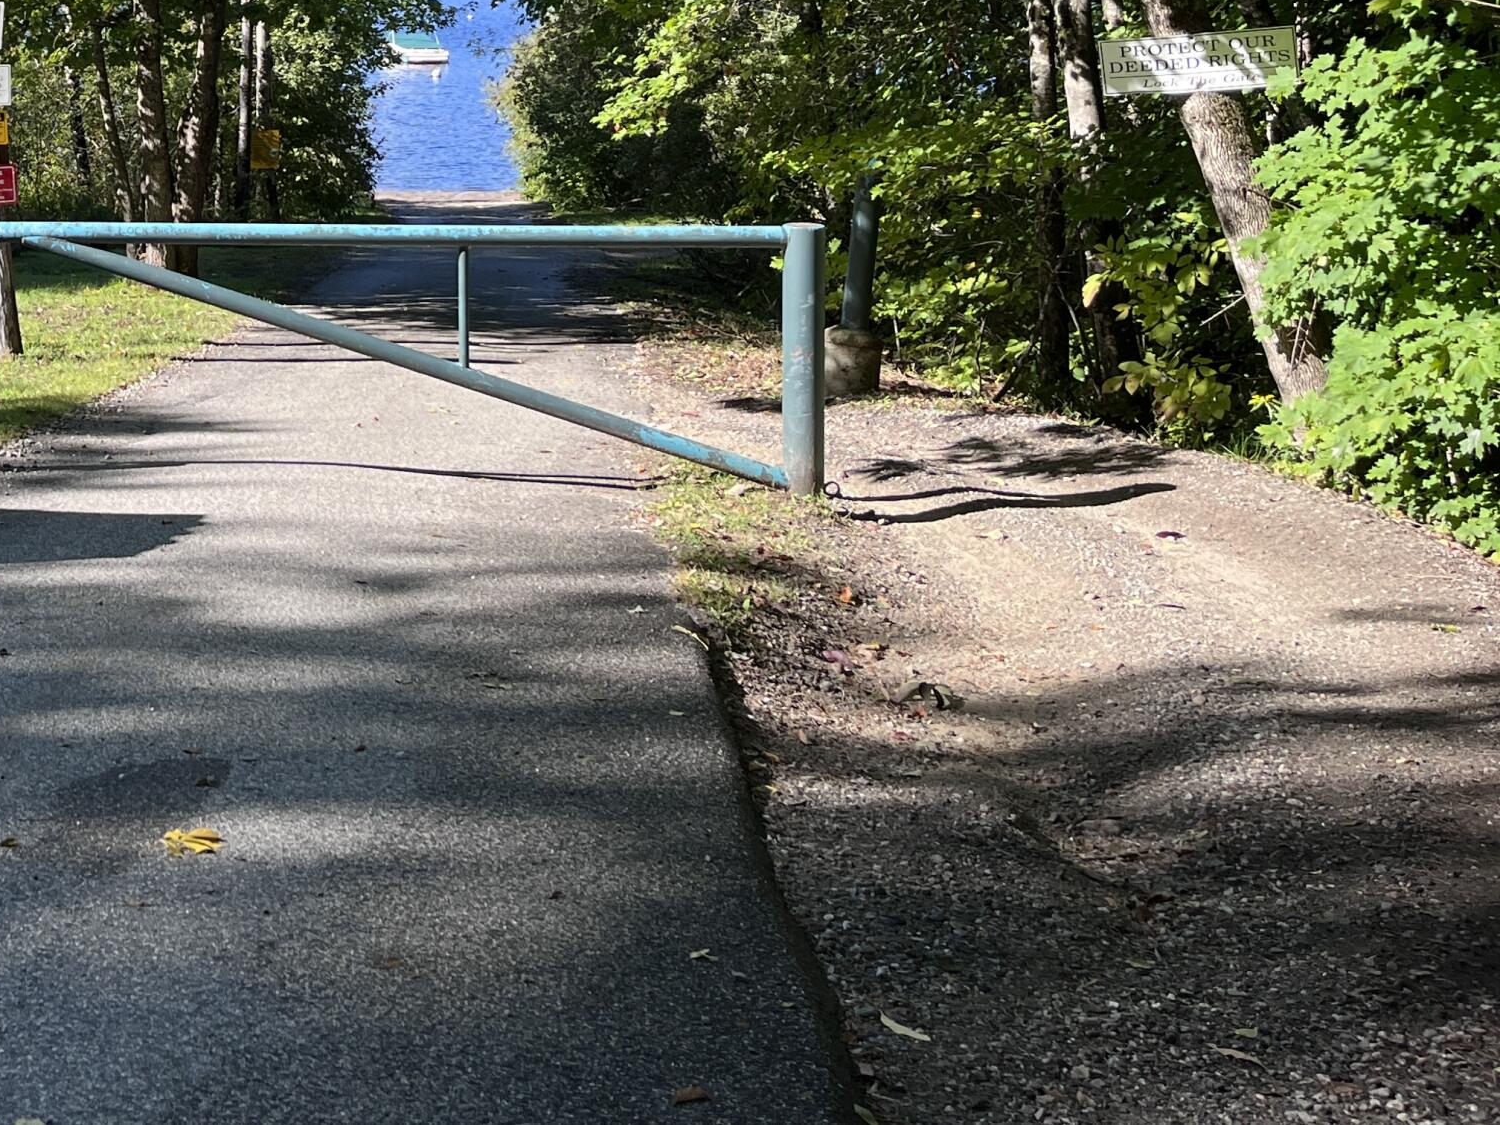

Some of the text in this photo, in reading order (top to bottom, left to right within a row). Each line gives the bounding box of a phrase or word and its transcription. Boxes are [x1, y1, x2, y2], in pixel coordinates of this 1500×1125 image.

[1120, 34, 1276, 58] PROTECT OUR
[1109, 49, 1291, 74] DEEDED RIGHTS
[1143, 74, 1260, 88] Lock The Gate
